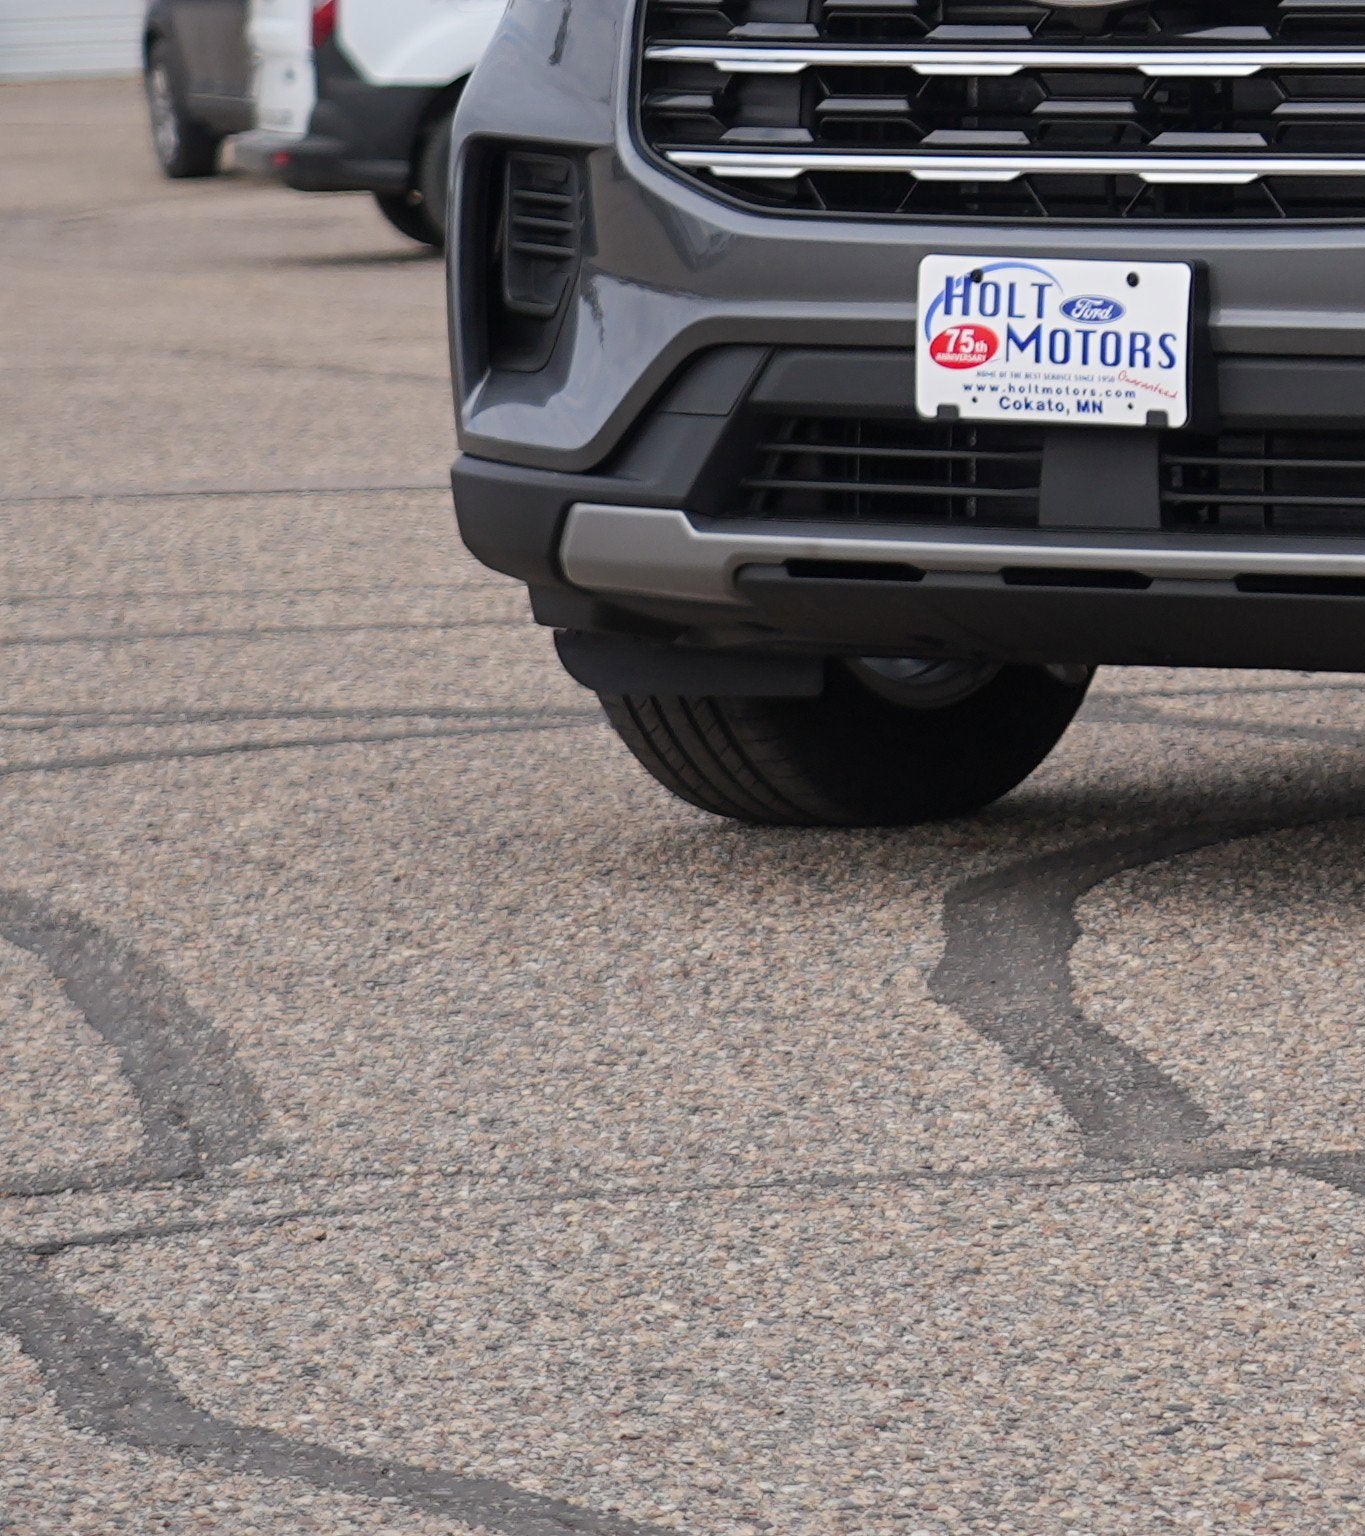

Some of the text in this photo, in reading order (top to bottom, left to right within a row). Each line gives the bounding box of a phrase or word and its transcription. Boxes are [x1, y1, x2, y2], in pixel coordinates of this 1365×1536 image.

[943, 274, 1053, 320] HOLT
[1070, 299, 1115, 320] Ford
[944, 327, 989, 354] 75th
[1005, 322, 1178, 370] MOTORS
[963, 383, 1136, 398] www.holtmotors.com
[999, 395, 1104, 416] Cokato, MN
